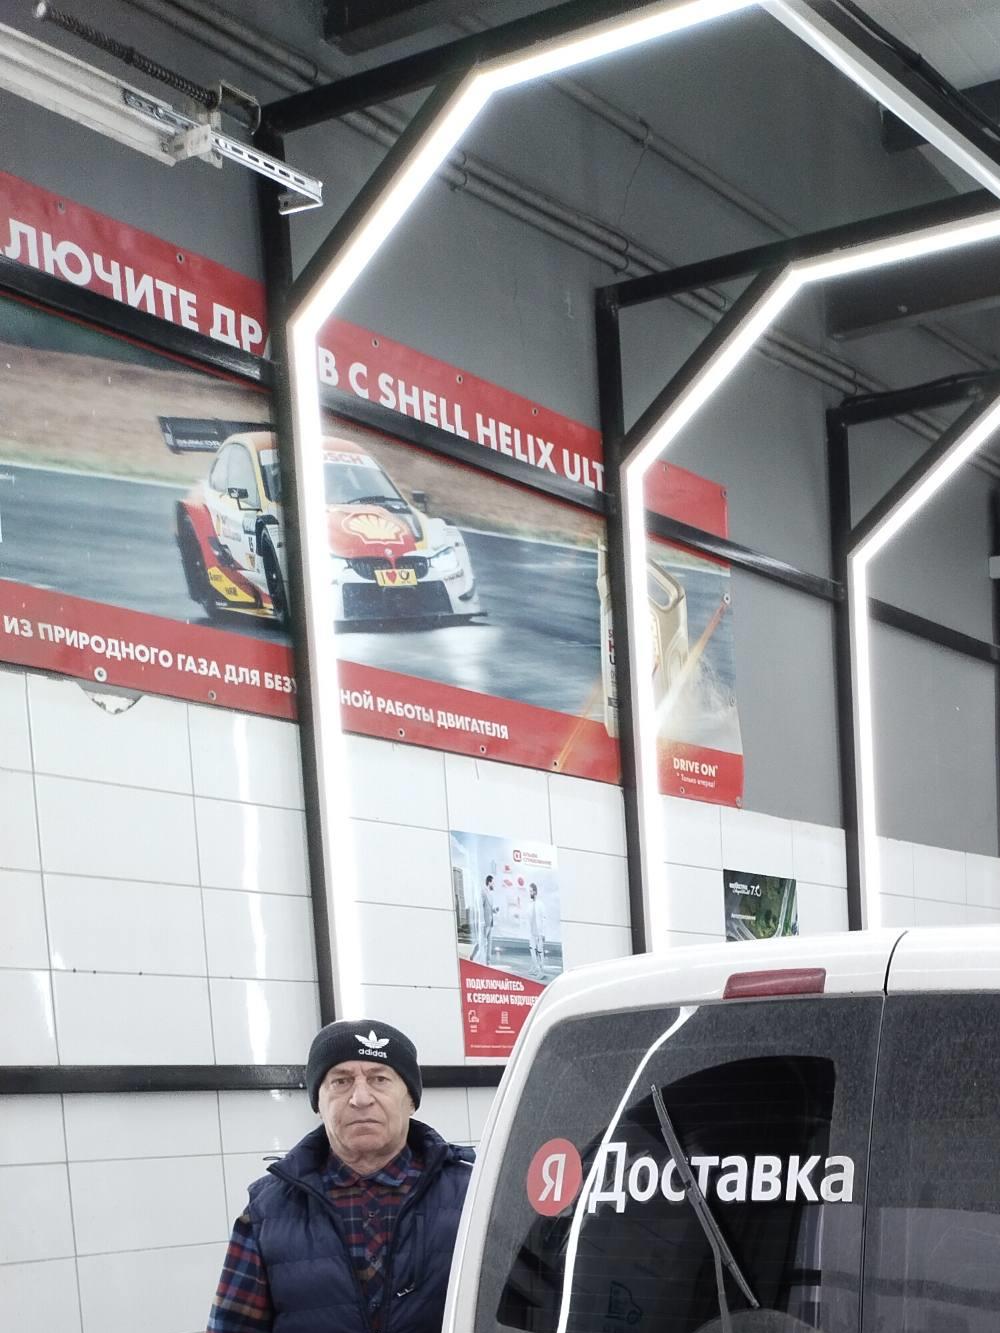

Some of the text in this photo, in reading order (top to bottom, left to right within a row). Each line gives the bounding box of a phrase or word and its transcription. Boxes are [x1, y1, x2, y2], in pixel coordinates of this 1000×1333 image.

[3, 218, 200, 333] ЛЮЧИТЕ
[378, 375, 469, 440] SHELL
[476, 411, 557, 474] HELIX
[562, 447, 605, 492] ULT
[3, 615, 33, 638] ИЗ
[38, 622, 174, 669] ПРИРОДНОГО
[177, 655, 221, 680] ГАЗА
[224, 664, 261, 687] ДЛЯ
[340, 689, 509, 740] НОЙ РАБОТЫ ДВИГАТЕЛЯ
[673, 757, 700, 776] DRIVE
[465, 978, 525, 992] ПОДКЛЮЧАЙТЕСЬ
[467, 993, 473, 1003] К
[473, 993, 509, 1005] СЕРВИСАМ
[358, 1048, 388, 1059] adidas
[538, 1141, 855, 1213] Я Доставка
